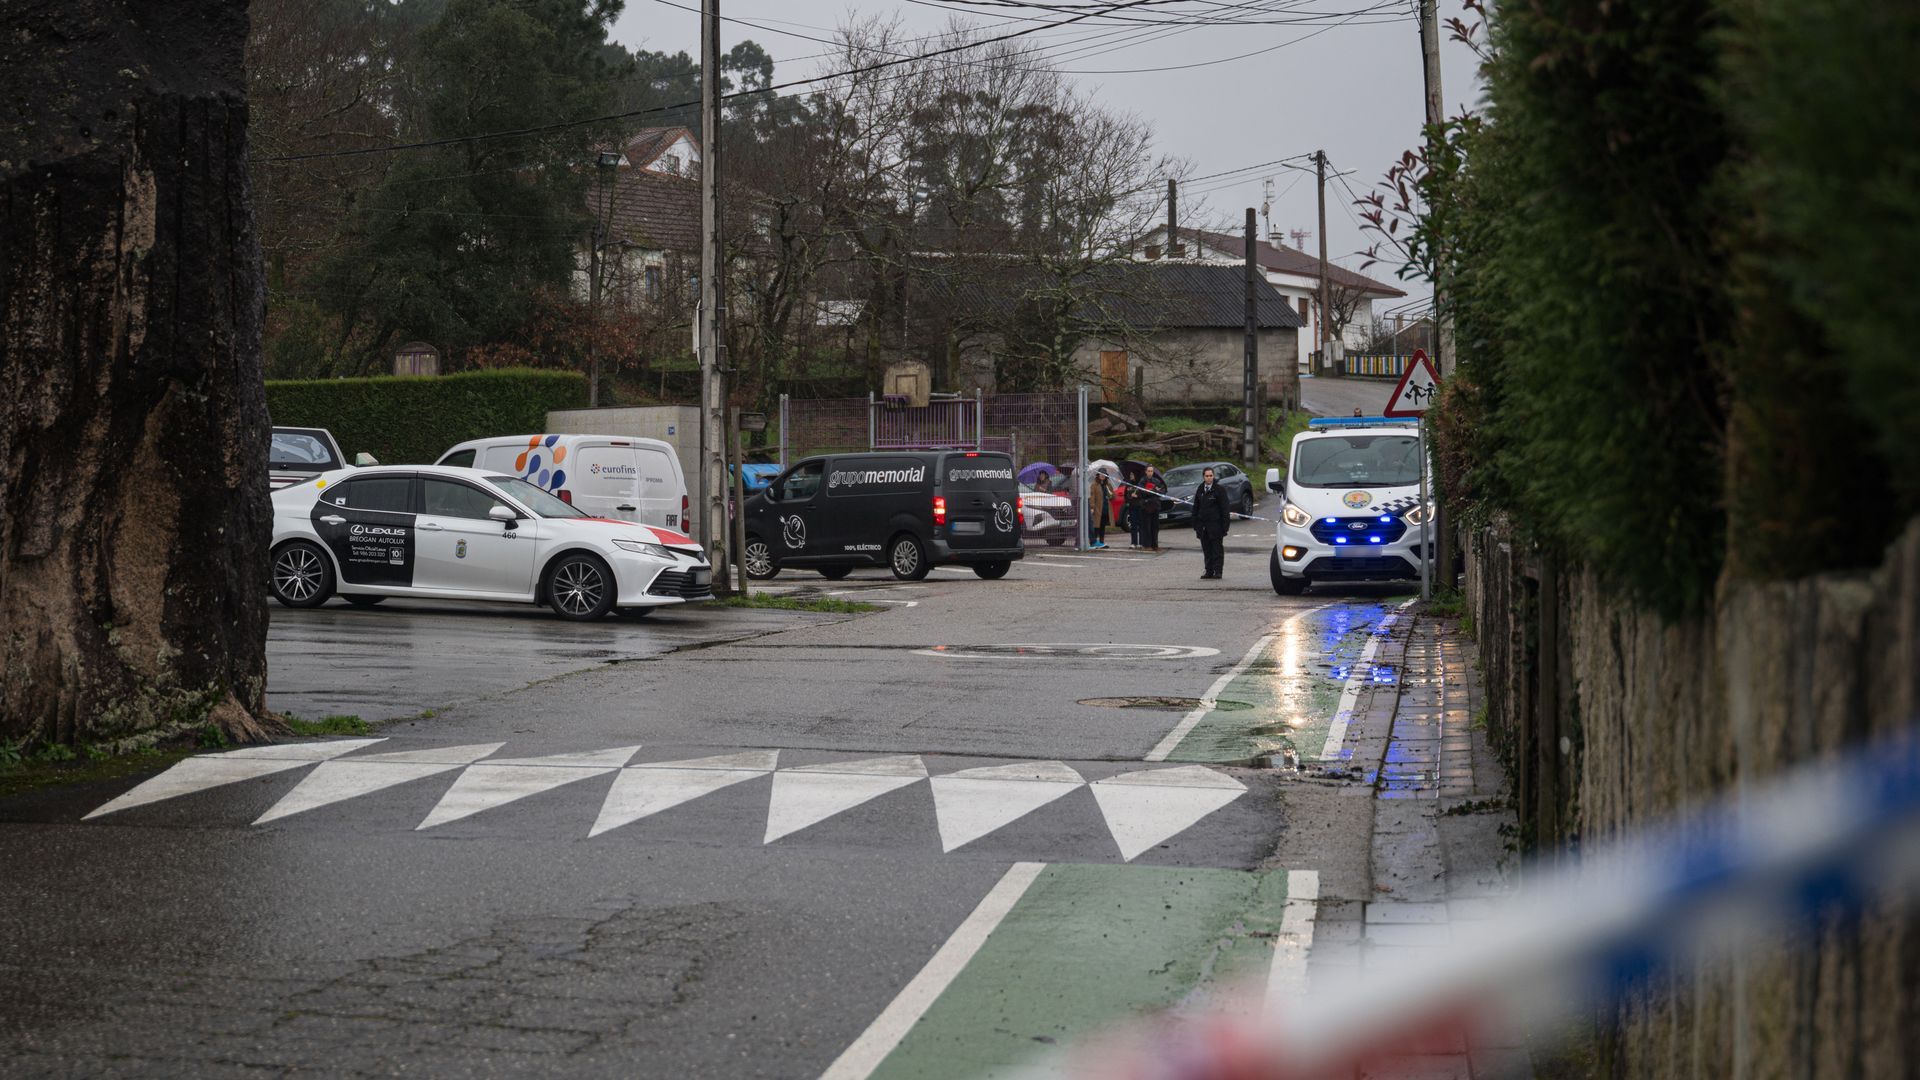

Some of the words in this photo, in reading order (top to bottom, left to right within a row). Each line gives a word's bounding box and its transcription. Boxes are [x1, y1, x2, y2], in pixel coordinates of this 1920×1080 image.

[602, 465, 636, 474] eurofins
[949, 468, 1013, 481] grupomemorial
[829, 466, 925, 488] grupomemorial
[666, 514, 678, 526] FIAT
[365, 527, 406, 536] LEXUS
[378, 537, 405, 545] AUTOLUX
